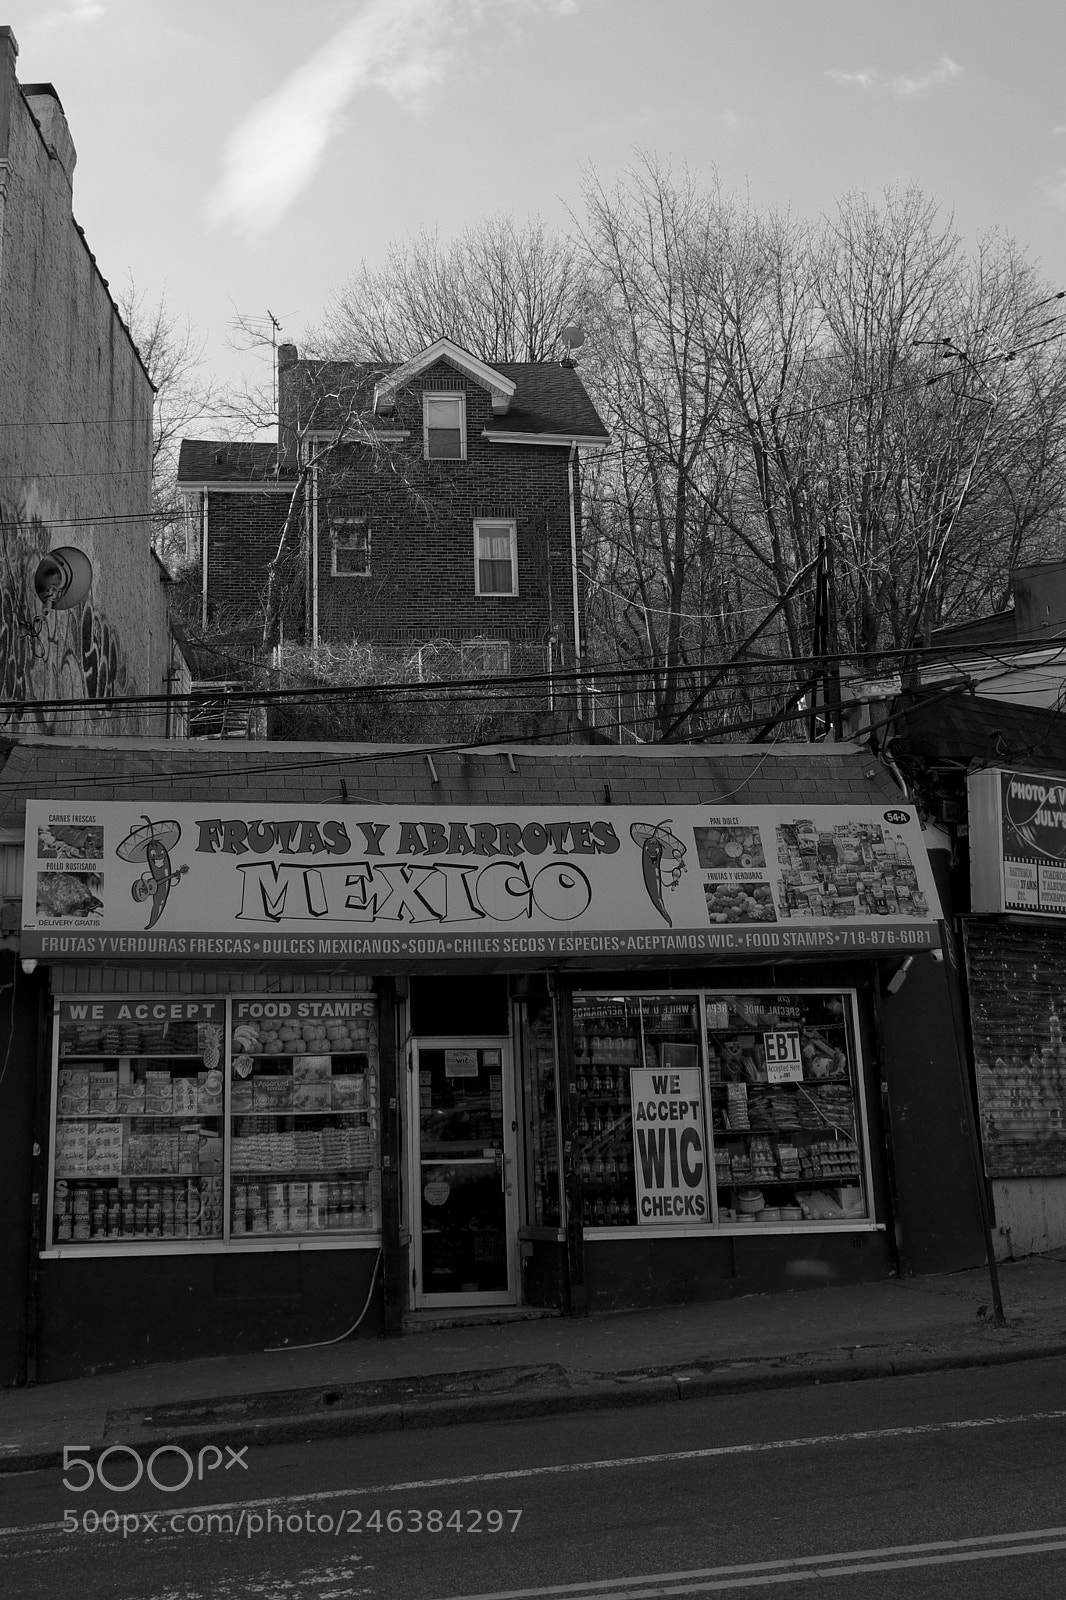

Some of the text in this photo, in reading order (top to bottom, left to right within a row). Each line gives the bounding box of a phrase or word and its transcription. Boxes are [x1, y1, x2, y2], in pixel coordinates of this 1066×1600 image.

[1011, 781, 1046, 803] PHOTO
[1048, 787, 1057, 804] &
[48, 814, 97, 823] CARNES FRESCAS
[709, 817, 740, 825] PAN DULCE
[886, 812, 907, 822] 54-A
[195, 818, 621, 857] FRUTAS Y ABARROTES
[46, 862, 97, 871] POLLO ROSTISADO
[707, 872, 728, 881] FRUTAS
[733, 871, 763, 880] VERDURAS
[234, 860, 592, 924] MEXICO
[38, 919, 73, 927] DELIVERY
[74, 919, 101, 927] GRATIS
[41, 936, 96, 953] FRUTAS
[98, 937, 107, 952] Y
[110, 937, 186, 954] VERDURAS
[190, 938, 251, 954] FRESCAS
[263, 938, 316, 955] DULCES
[318, 938, 400, 955] MEXICANOS
[408, 938, 446, 954] SODA
[454, 938, 500, 953] CHILES
[503, 937, 546, 952] SECOS
[548, 937, 556, 952] Y
[559, 936, 620, 952] ESPECIES
[627, 934, 705, 950] ACEPTAMOS
[746, 932, 780, 948] FOOD
[783, 931, 835, 947] STAMPS
[840, 930, 932, 946] 718-876-6081
[69, 1003, 216, 1020] WE ACCEPT
[238, 1001, 375, 1018] FOOD STAMPS
[764, 1032, 799, 1061] EBT
[651, 1074, 681, 1095] WE
[636, 1100, 700, 1122] ACCEPT
[636, 1126, 704, 1189] WIC
[640, 1194, 706, 1217] CHECKS
